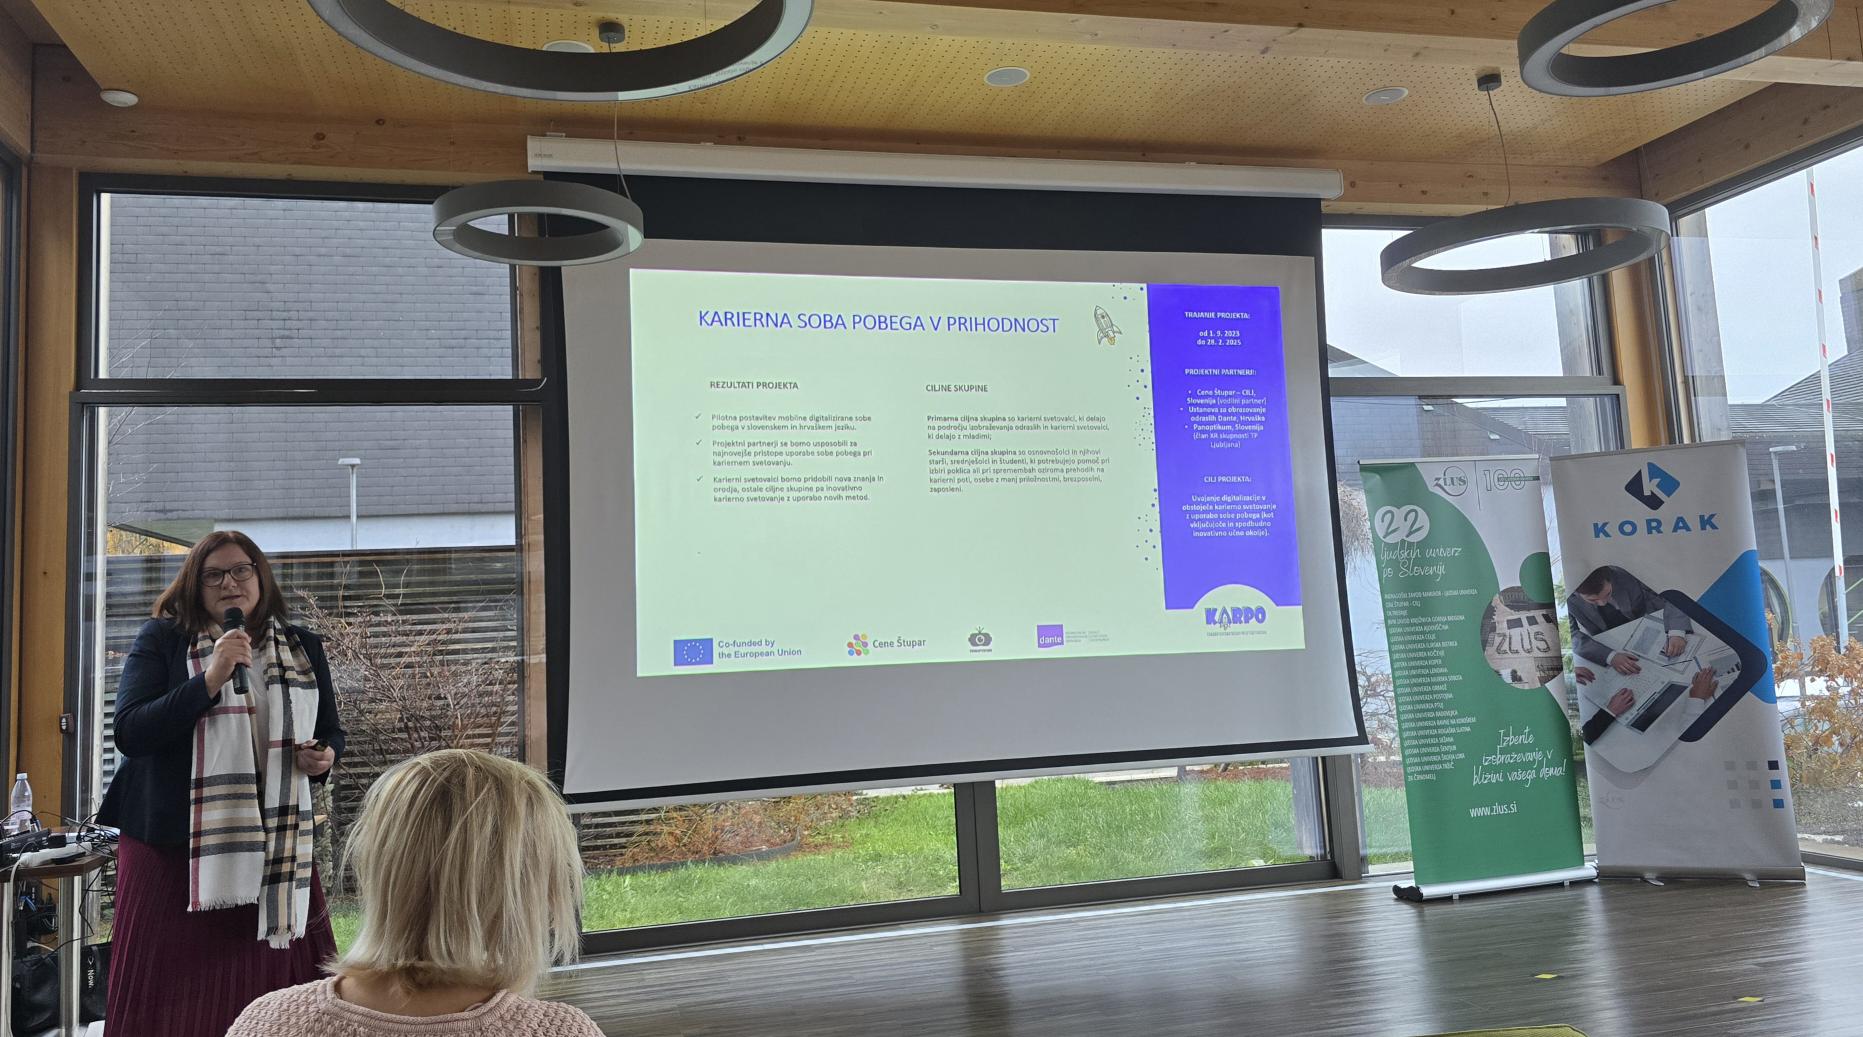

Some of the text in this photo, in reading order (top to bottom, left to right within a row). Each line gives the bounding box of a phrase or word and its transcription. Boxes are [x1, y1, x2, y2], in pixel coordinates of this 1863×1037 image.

[699, 311, 1060, 334] KARIERNA SOBA POBEGA V PRIHODNOST
[710, 381, 799, 389] REZULTATI PROJEKTA
[738, 414, 776, 423] postavitev
[809, 414, 854, 423] digitalizirane
[712, 423, 740, 432] pobega
[712, 440, 746, 449] Projektni
[747, 440, 779, 449] partnerji
[812, 440, 848, 449] usposobili
[712, 449, 752, 458] najnovejše
[753, 449, 784, 458] pristope
[835, 449, 862, 458] pobega
[803, 475, 833, 484] pridobili
[853, 474, 876, 484] znanja
[713, 485, 740, 494] orodja,
[786, 484, 814, 494] skupine
[746, 494, 785, 503] svetovanje
[792, 494, 822, 503] uporabo
[1381, 508, 1425, 539] 22
[1593, 513, 1719, 538] KORAK
[1380, 540, 1462, 567] ljudskih univerz
[1382, 568, 1394, 583] po
[1205, 606, 1266, 625] KARPO
[718, 638, 775, 648] Co-funded by
[872, 638, 926, 649] Cene Štupar
[1040, 636, 1062, 644] dante
[1496, 629, 1550, 655] ZLUS
[718, 648, 802, 660] the European Union
[1472, 765, 1504, 787] bližini
[1507, 769, 1536, 788] vašega
[1540, 758, 1566, 780] doma!
[1470, 801, 1518, 818] www.zlus.si
